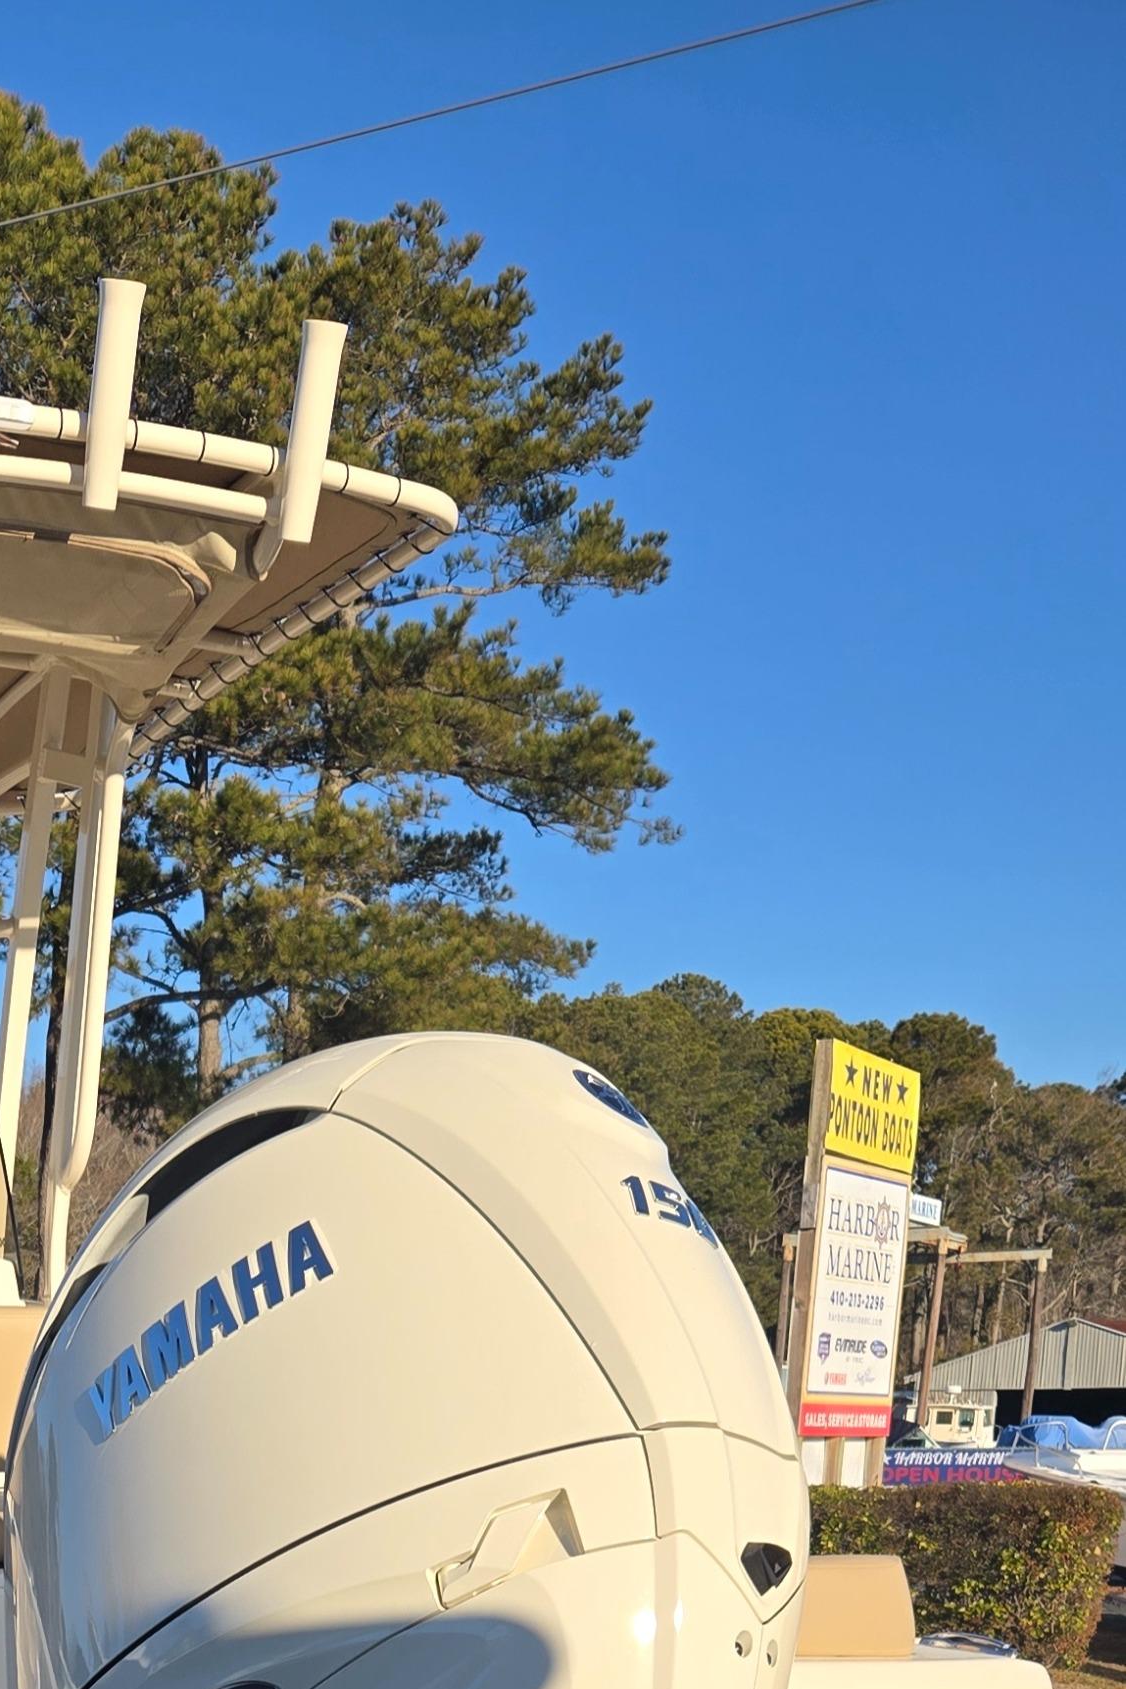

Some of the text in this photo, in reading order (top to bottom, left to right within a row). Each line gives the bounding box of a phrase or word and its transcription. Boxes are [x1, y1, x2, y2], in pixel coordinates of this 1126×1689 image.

[862, 1066, 893, 1104] NEW
[826, 1092, 913, 1159] PONTOON BOATS
[911, 1199, 937, 1220] MARINE
[826, 1244, 892, 1285] MARINE
[830, 1290, 884, 1310] 410-213-2296
[84, 1220, 334, 1440] YAMAHA
[894, 1451, 954, 1466] HARBOR
[883, 1466, 939, 1483] OPEN
